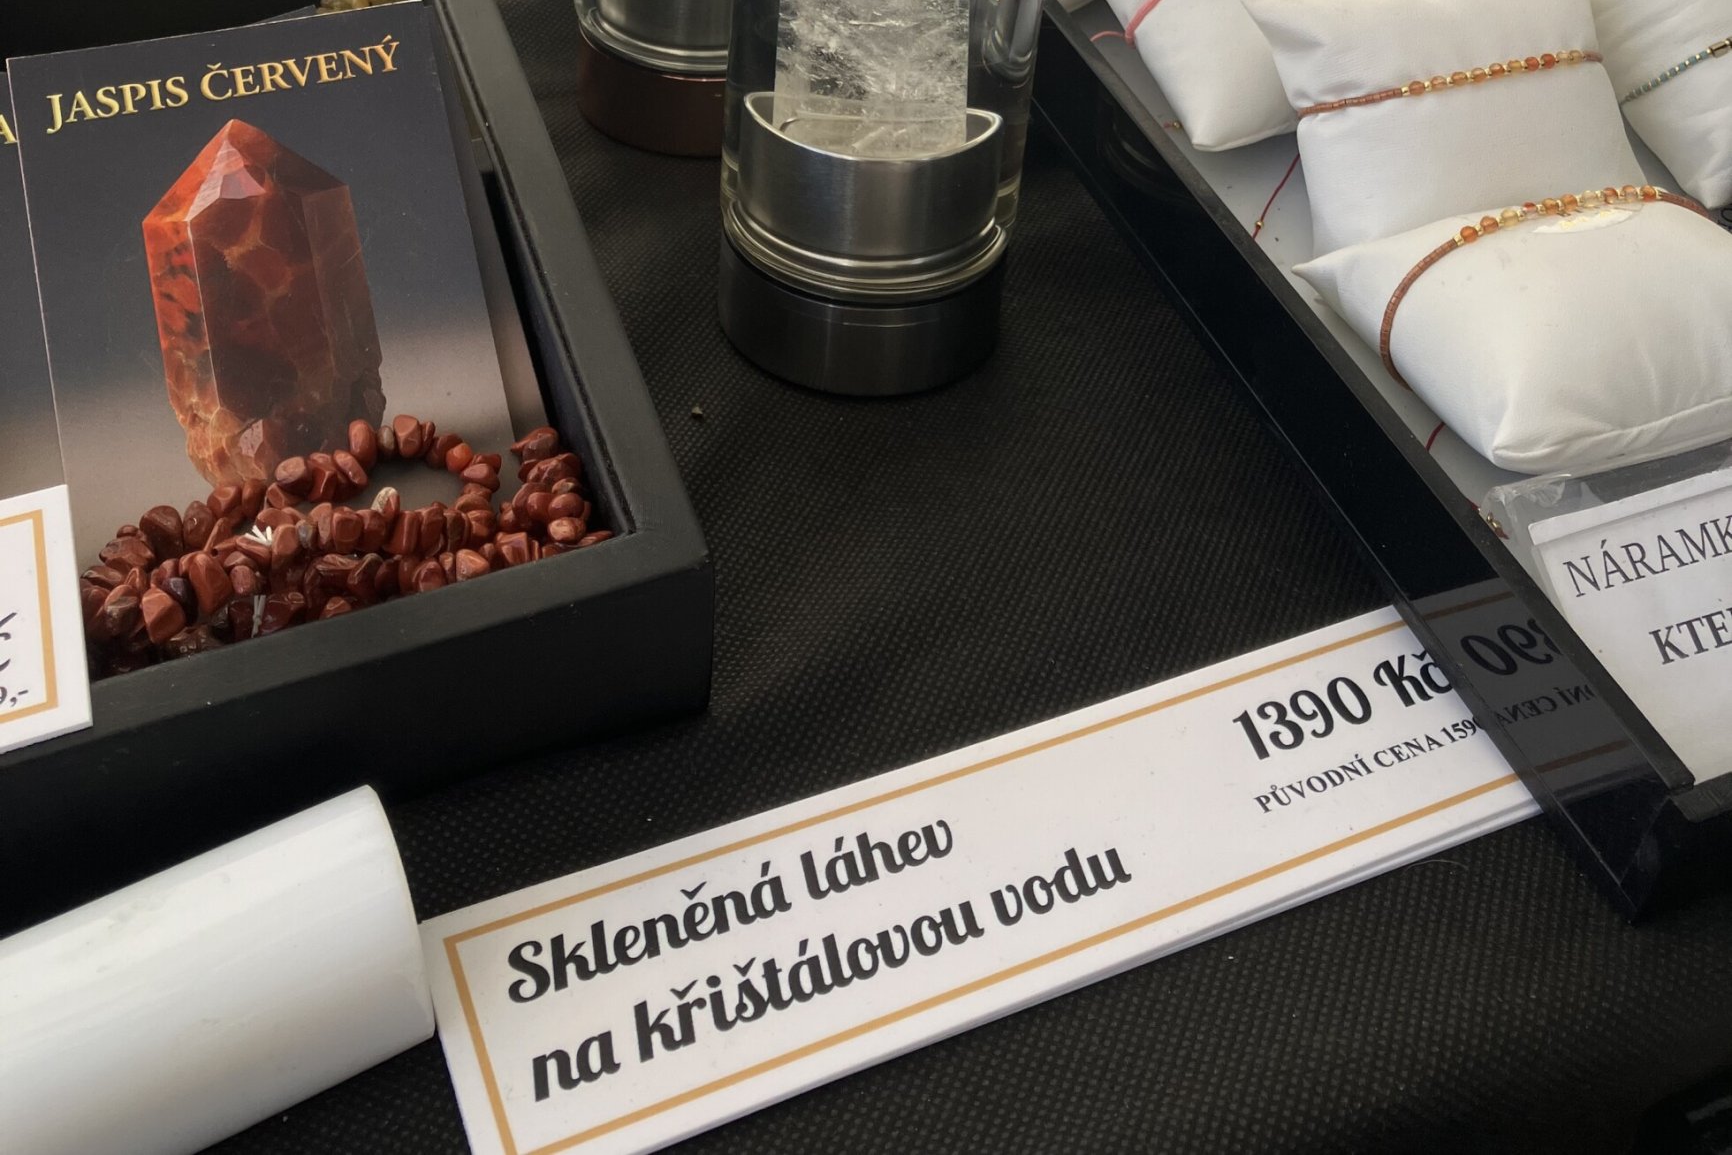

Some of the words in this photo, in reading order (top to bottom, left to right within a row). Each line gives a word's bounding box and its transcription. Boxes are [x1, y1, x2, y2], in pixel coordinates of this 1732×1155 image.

[46, 76, 190, 135] JASPIS
[199, 34, 401, 102] ČERVENÝ
[1648, 606, 1732, 665] KTE
[1232, 675, 1373, 761] 1390
[1373, 647, 1455, 708] Kč
[1254, 753, 1374, 814] PŮVODNÍ
[1373, 734, 1446, 769] CENA
[507, 860, 793, 1004] Skleněná
[800, 818, 954, 900] láhev
[532, 1031, 621, 1102] na
[990, 846, 1132, 927] vodu
